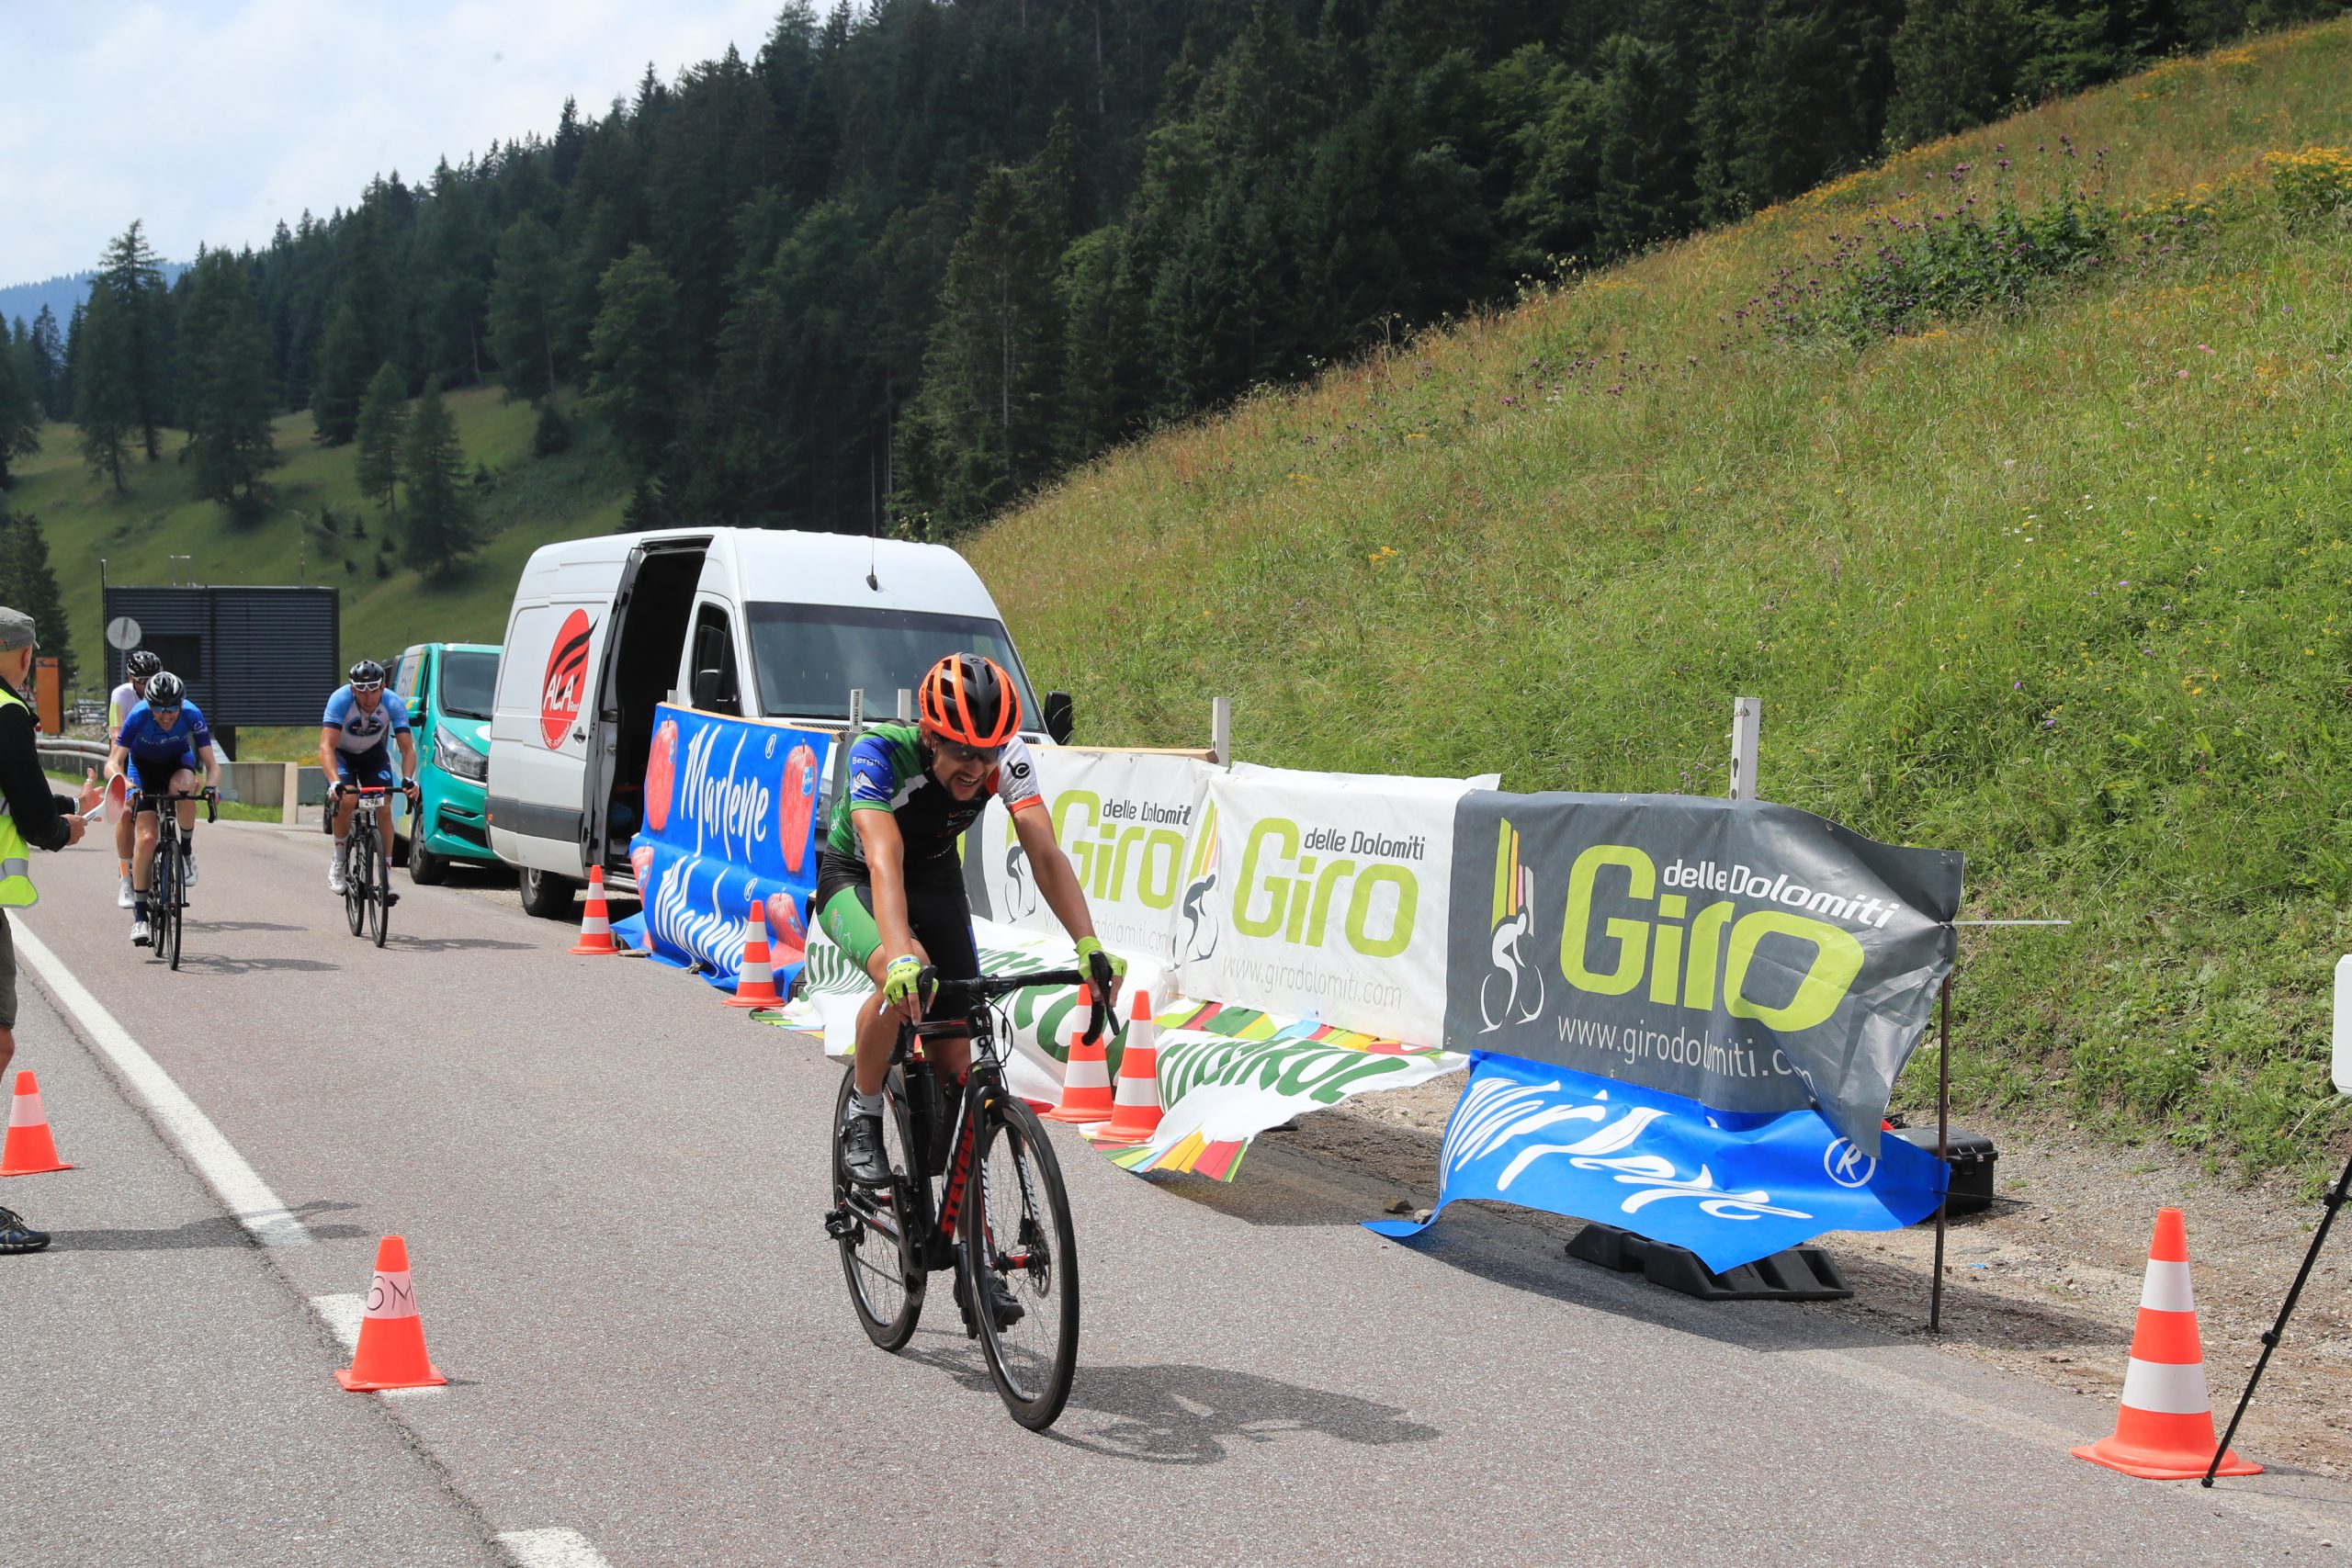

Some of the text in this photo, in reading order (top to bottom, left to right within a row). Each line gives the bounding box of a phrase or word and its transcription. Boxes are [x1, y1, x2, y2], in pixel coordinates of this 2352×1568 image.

[543, 673, 574, 712] ALA
[681, 723, 769, 863] Marlene
[1102, 798, 1137, 820] delle
[1051, 789, 1185, 910] Giro
[1304, 827, 1426, 861] delle Dolomiti
[1232, 817, 1419, 958] Giro
[1663, 858, 1901, 929] delle Dolomiti
[1559, 844, 1865, 1032] Giro
[1222, 953, 1403, 1010] www.girodolomiti.com
